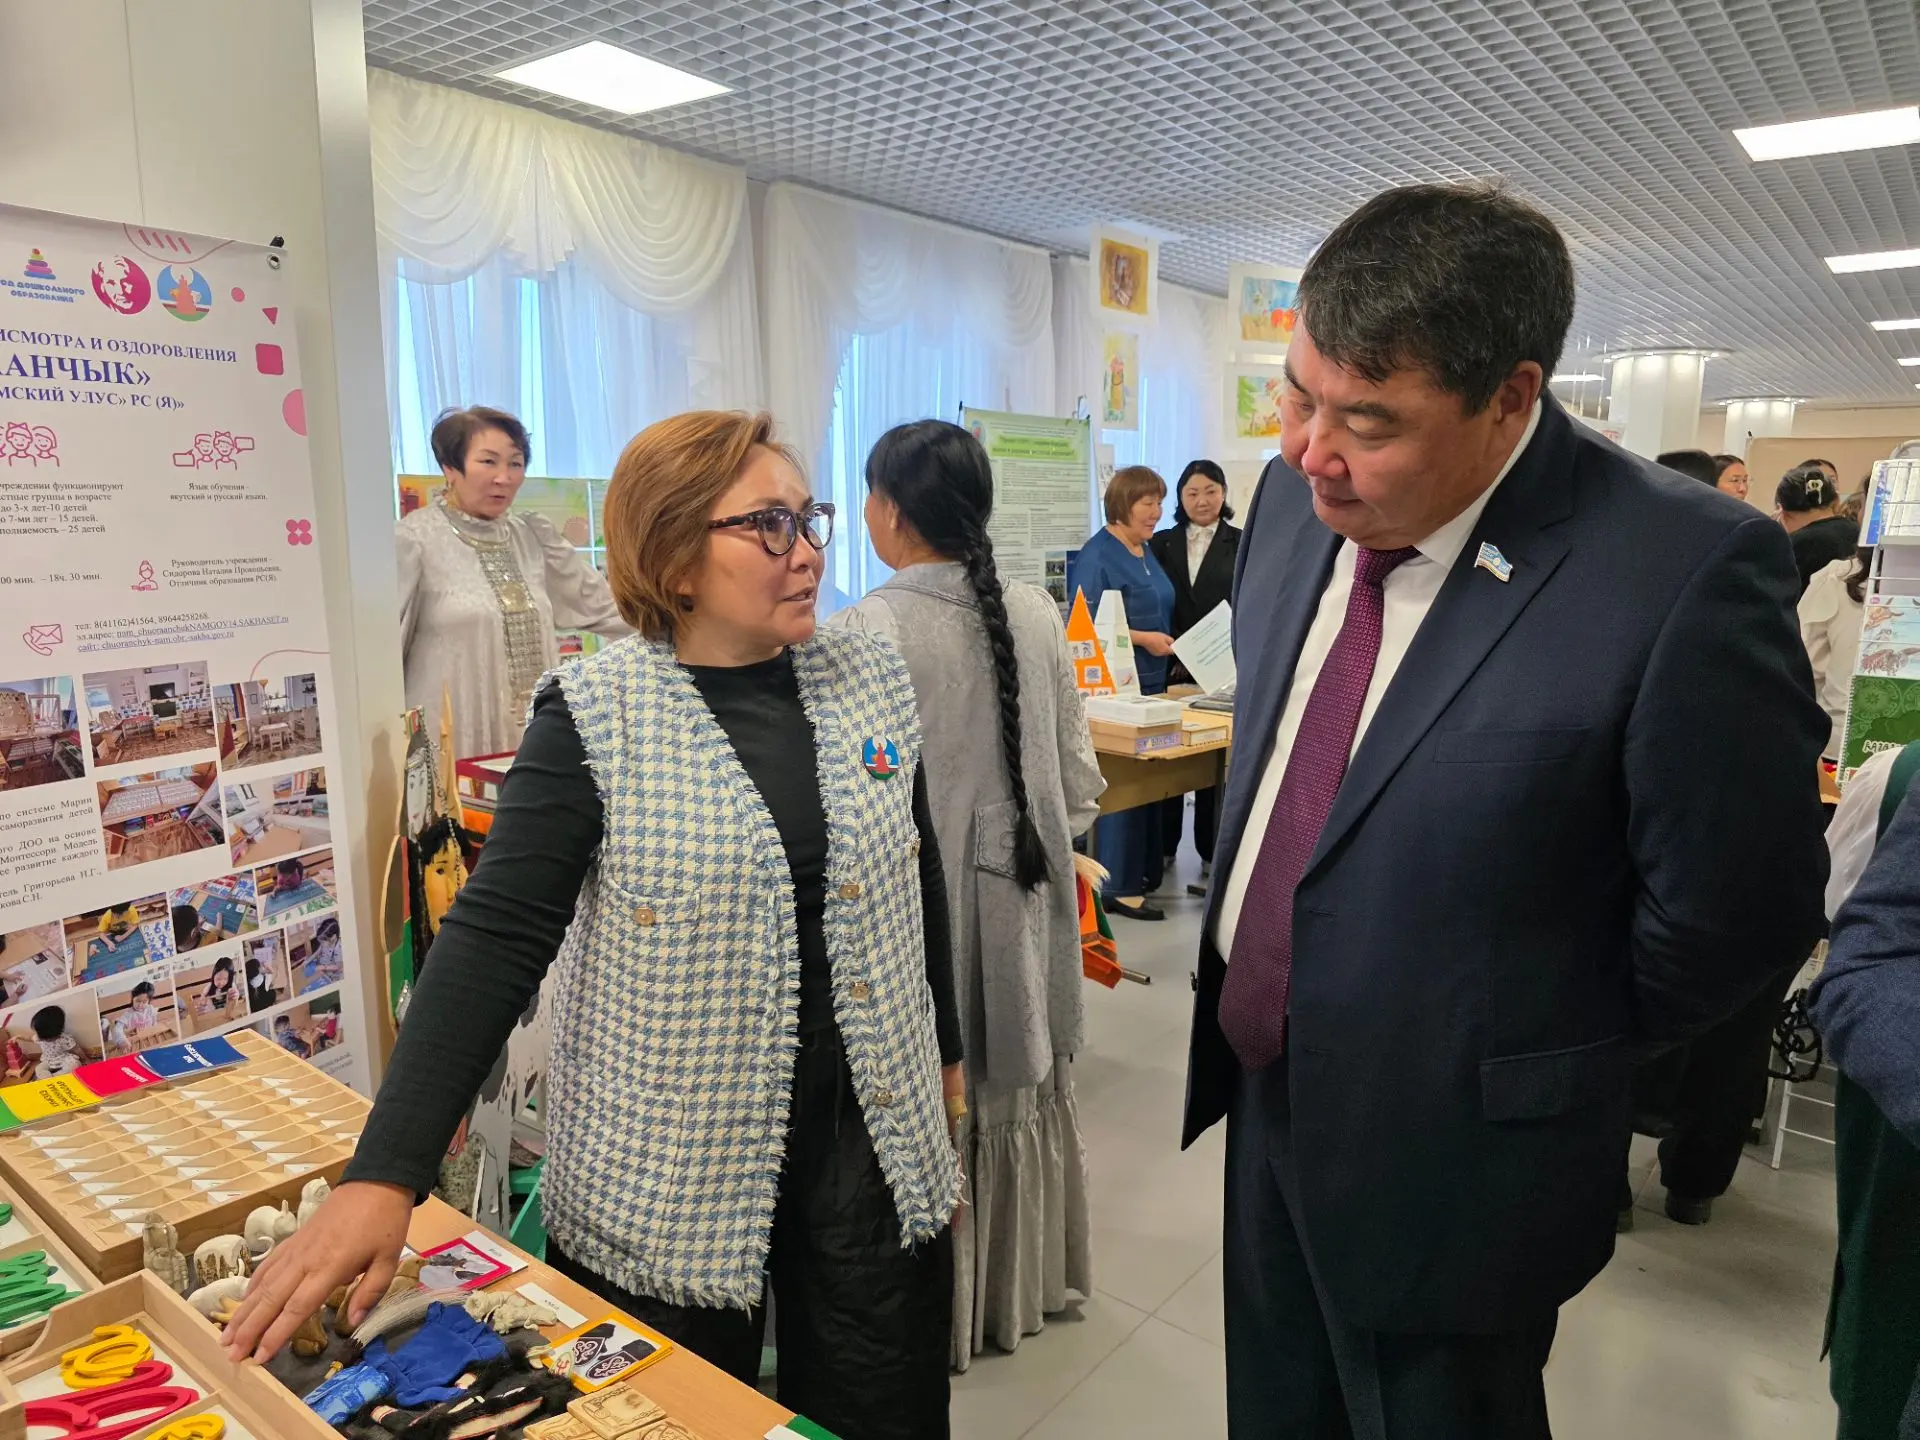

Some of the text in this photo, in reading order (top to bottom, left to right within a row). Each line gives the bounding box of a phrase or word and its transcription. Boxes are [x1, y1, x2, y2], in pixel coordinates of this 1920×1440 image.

[91, 337, 102, 350] И
[108, 339, 238, 363] ОЗДОРОВЛЕНИЯ
[0, 353, 151, 386] АНЧЫК»
[70, 390, 126, 406] УЛУС»
[131, 394, 152, 408] РС
[156, 395, 185, 412] (Я)»
[63, 504, 88, 512] детей
[0, 807, 94, 831] саморазвития детей
[17, 804, 55, 817] системе
[61, 797, 92, 810] Марии
[0, 838, 98, 865] Монтессори Модель
[19, 838, 43, 852] ДОО
[65, 828, 97, 840] основе
[15, 858, 57, 875] развитие
[62, 849, 99, 862] каждого
[24, 874, 76, 893] Григорьева
